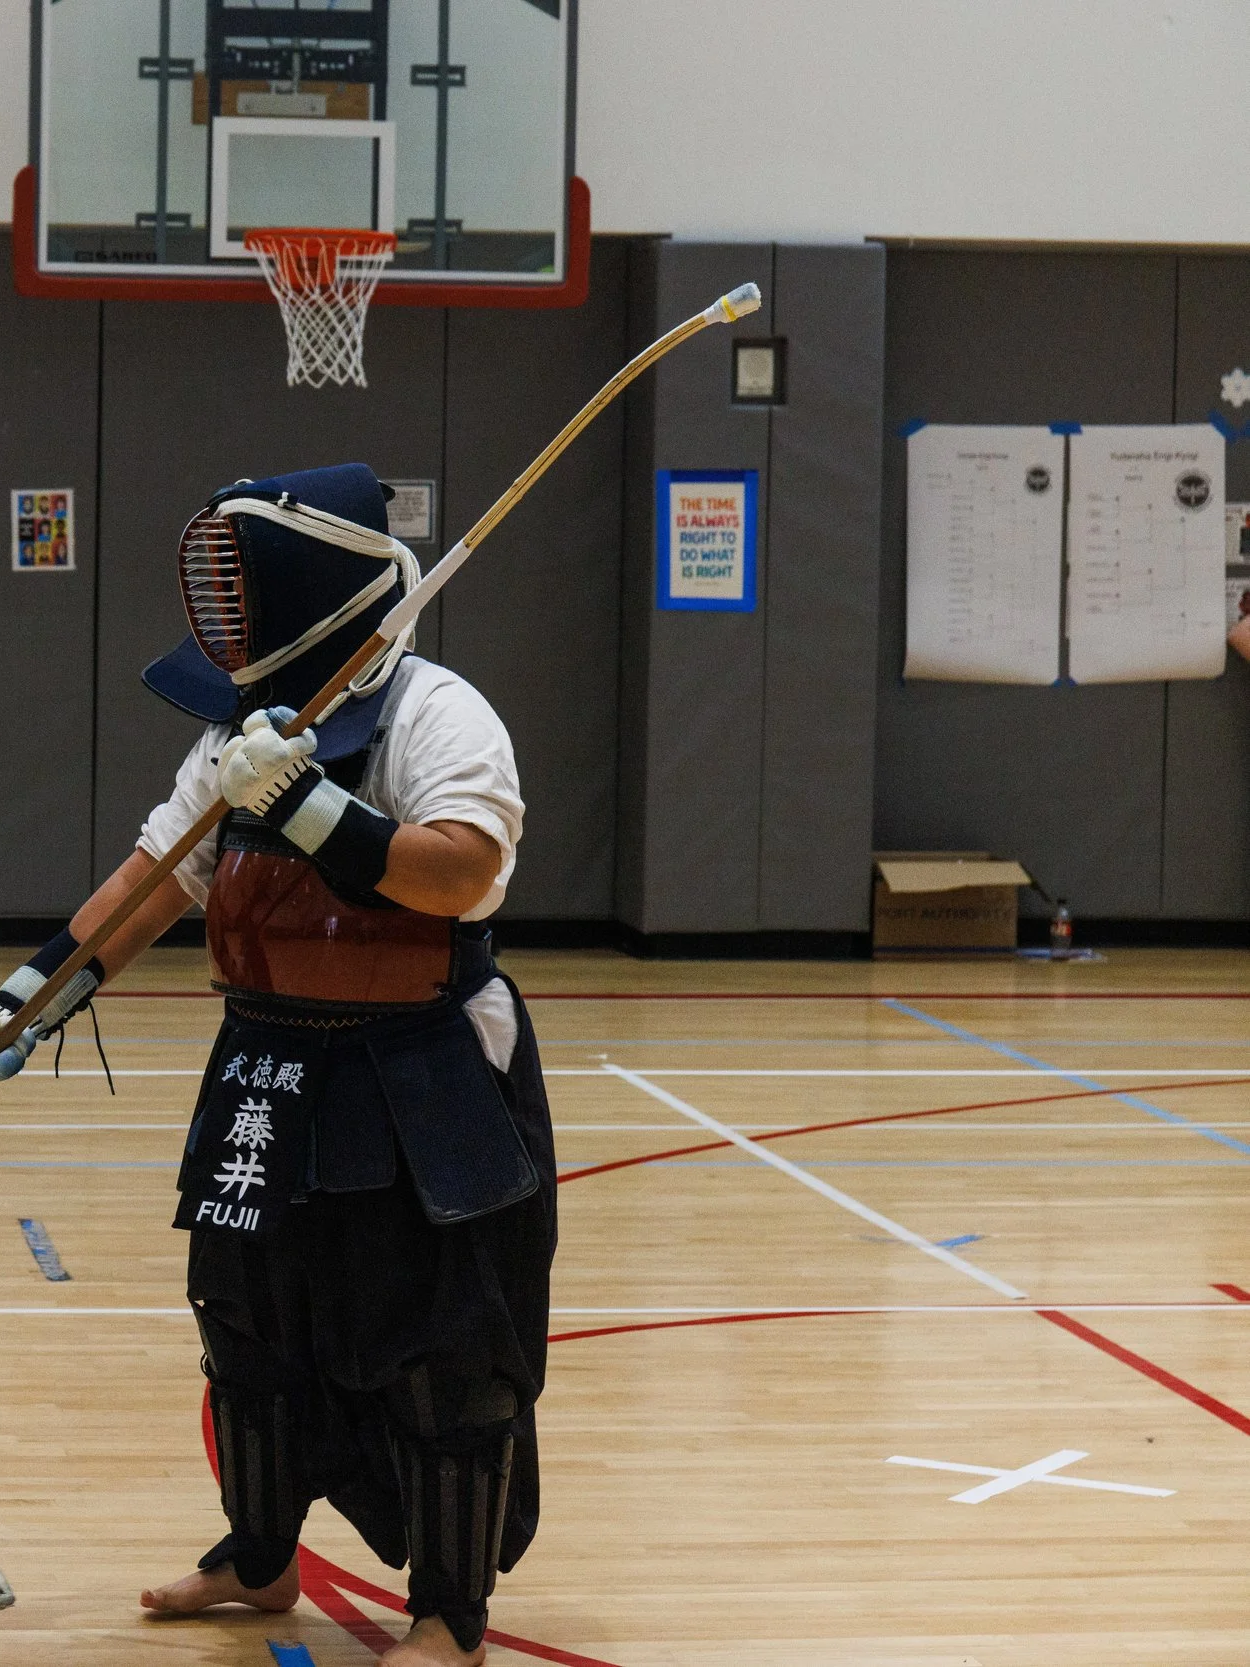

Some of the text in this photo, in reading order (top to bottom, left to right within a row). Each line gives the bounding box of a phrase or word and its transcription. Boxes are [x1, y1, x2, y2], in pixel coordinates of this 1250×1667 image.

[679, 496, 736, 511] THE TIME
[676, 514, 739, 528] IS ALWAYS
[680, 532, 736, 544] RIGHT TO
[680, 548, 735, 561] DO WHAT
[682, 565, 733, 578] IS RIGHT
[221, 1052, 304, 1094] 武徳殿
[213, 1097, 275, 1201] 藤井
[196, 1201, 260, 1231] FUJII
